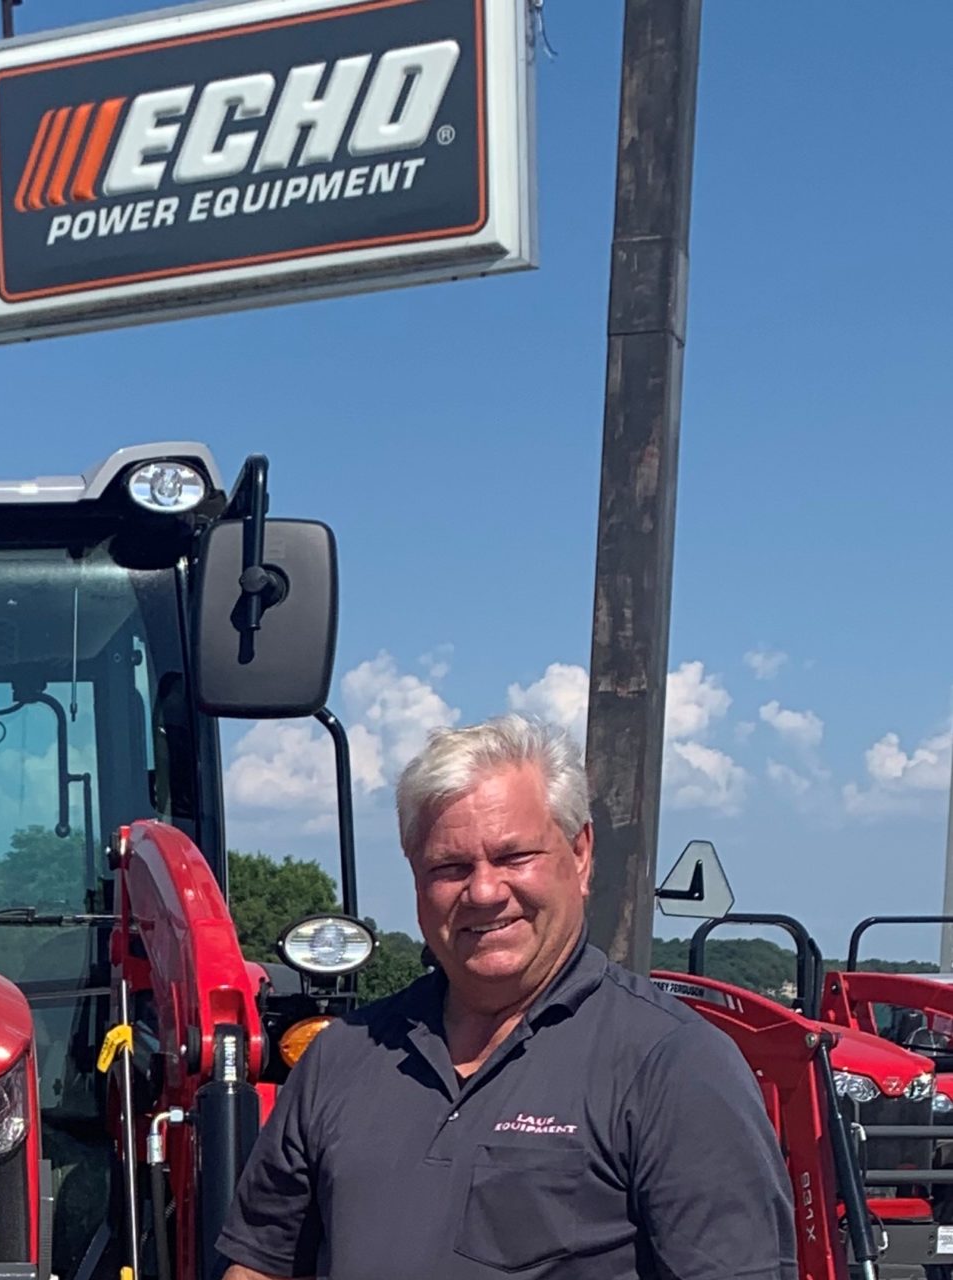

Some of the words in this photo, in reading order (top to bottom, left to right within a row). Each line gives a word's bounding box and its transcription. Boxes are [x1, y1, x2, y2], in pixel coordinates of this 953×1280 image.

[102, 40, 460, 196] ECHO
[46, 196, 180, 246] POWER
[188, 158, 426, 222] EQUIPMENT
[494, 1122, 578, 1134] EQUIPMENT
[516, 1113, 556, 1126] LAUF
